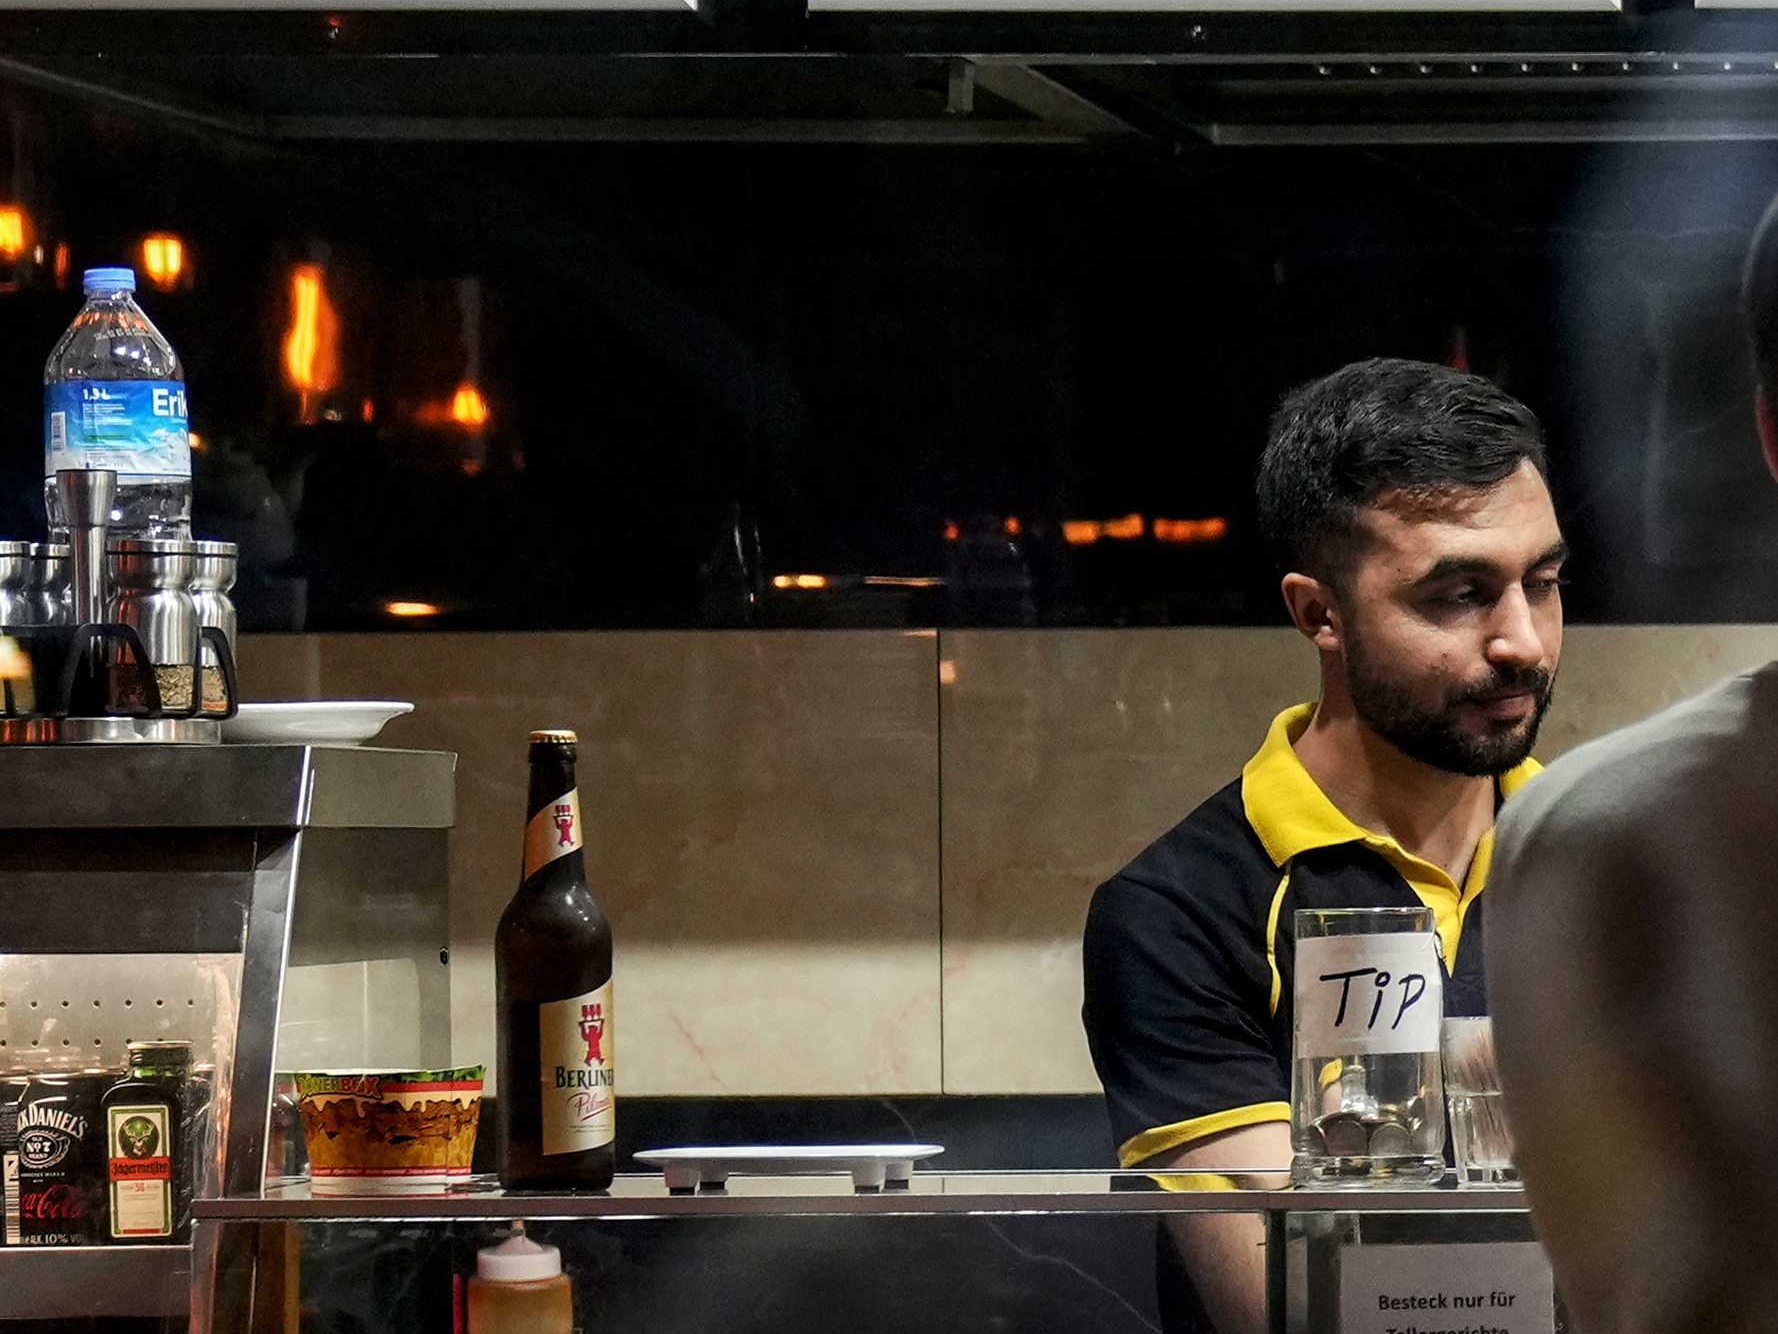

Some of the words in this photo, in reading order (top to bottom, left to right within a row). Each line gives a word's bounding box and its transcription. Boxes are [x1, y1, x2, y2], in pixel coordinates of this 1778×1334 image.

[1379, 1292, 1447, 1312] Besteck
[1453, 1295, 1485, 1312] nur
[1490, 1290, 1516, 1311] für
